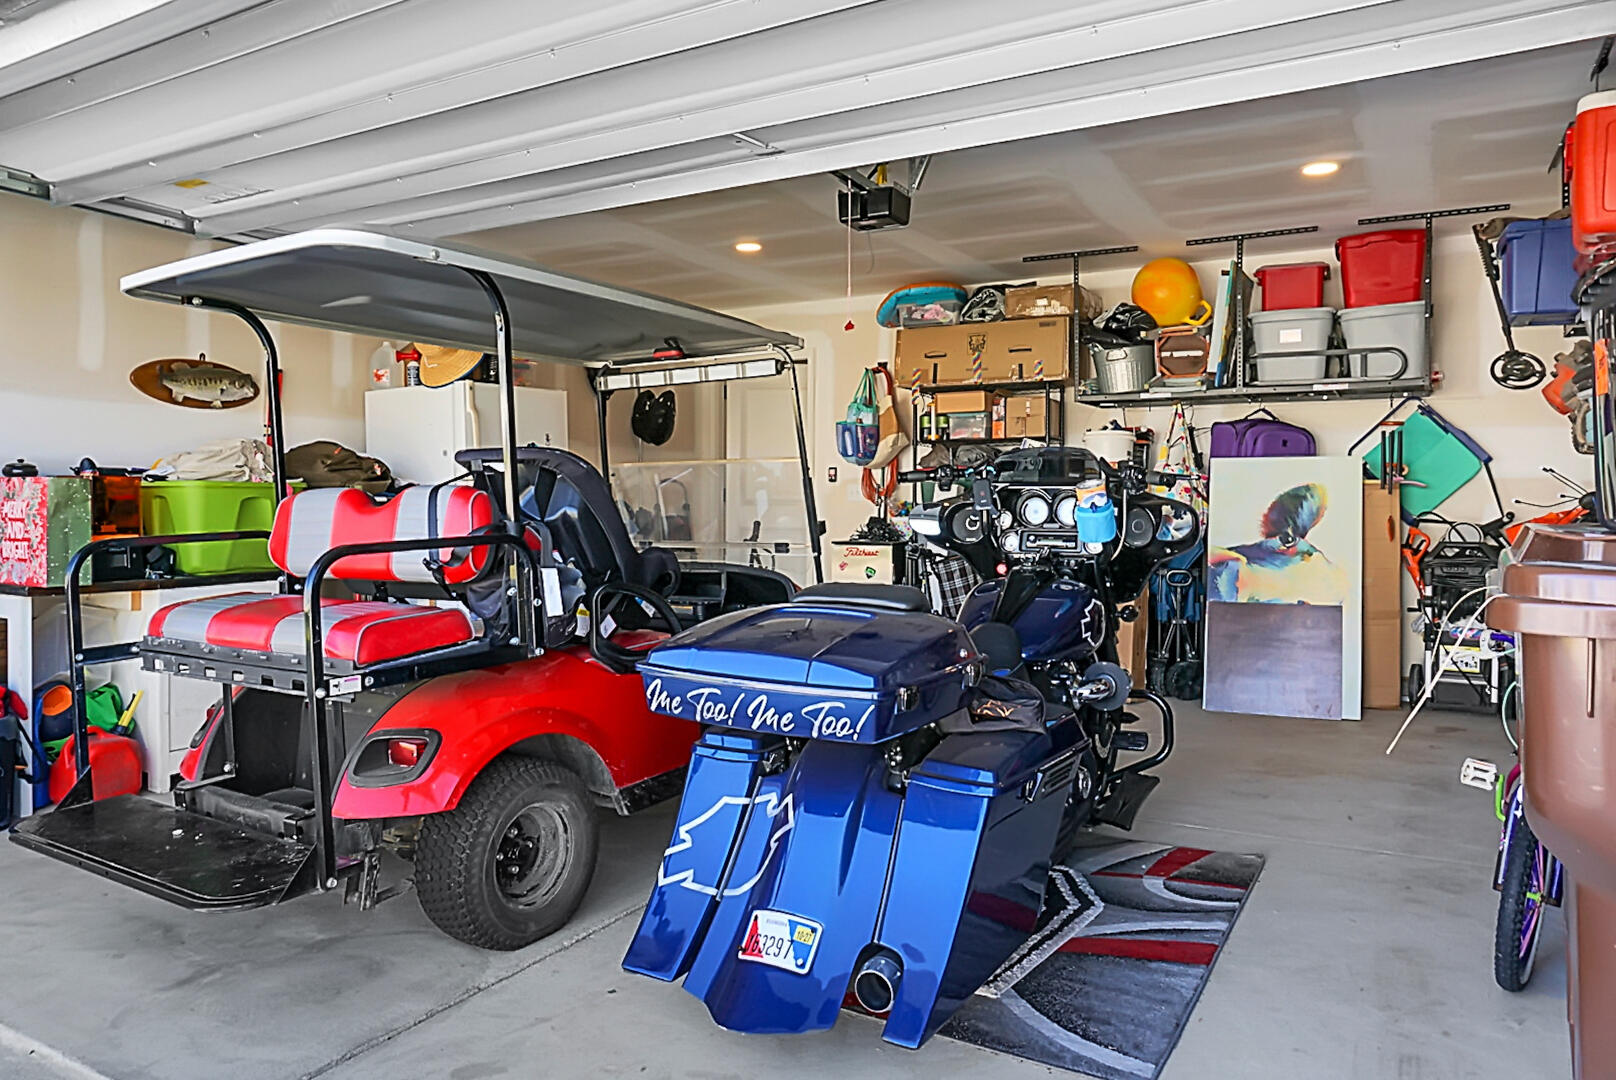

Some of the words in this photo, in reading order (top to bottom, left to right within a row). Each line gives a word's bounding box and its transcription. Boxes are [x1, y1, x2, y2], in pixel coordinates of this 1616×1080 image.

[7, 520, 25, 538] AND
[2, 540, 29, 559] BRIGHT
[646, 678, 683, 715] Me
[686, 687, 746, 726] Too!
[747, 694, 795, 732] Me
[801, 701, 876, 741] Too!
